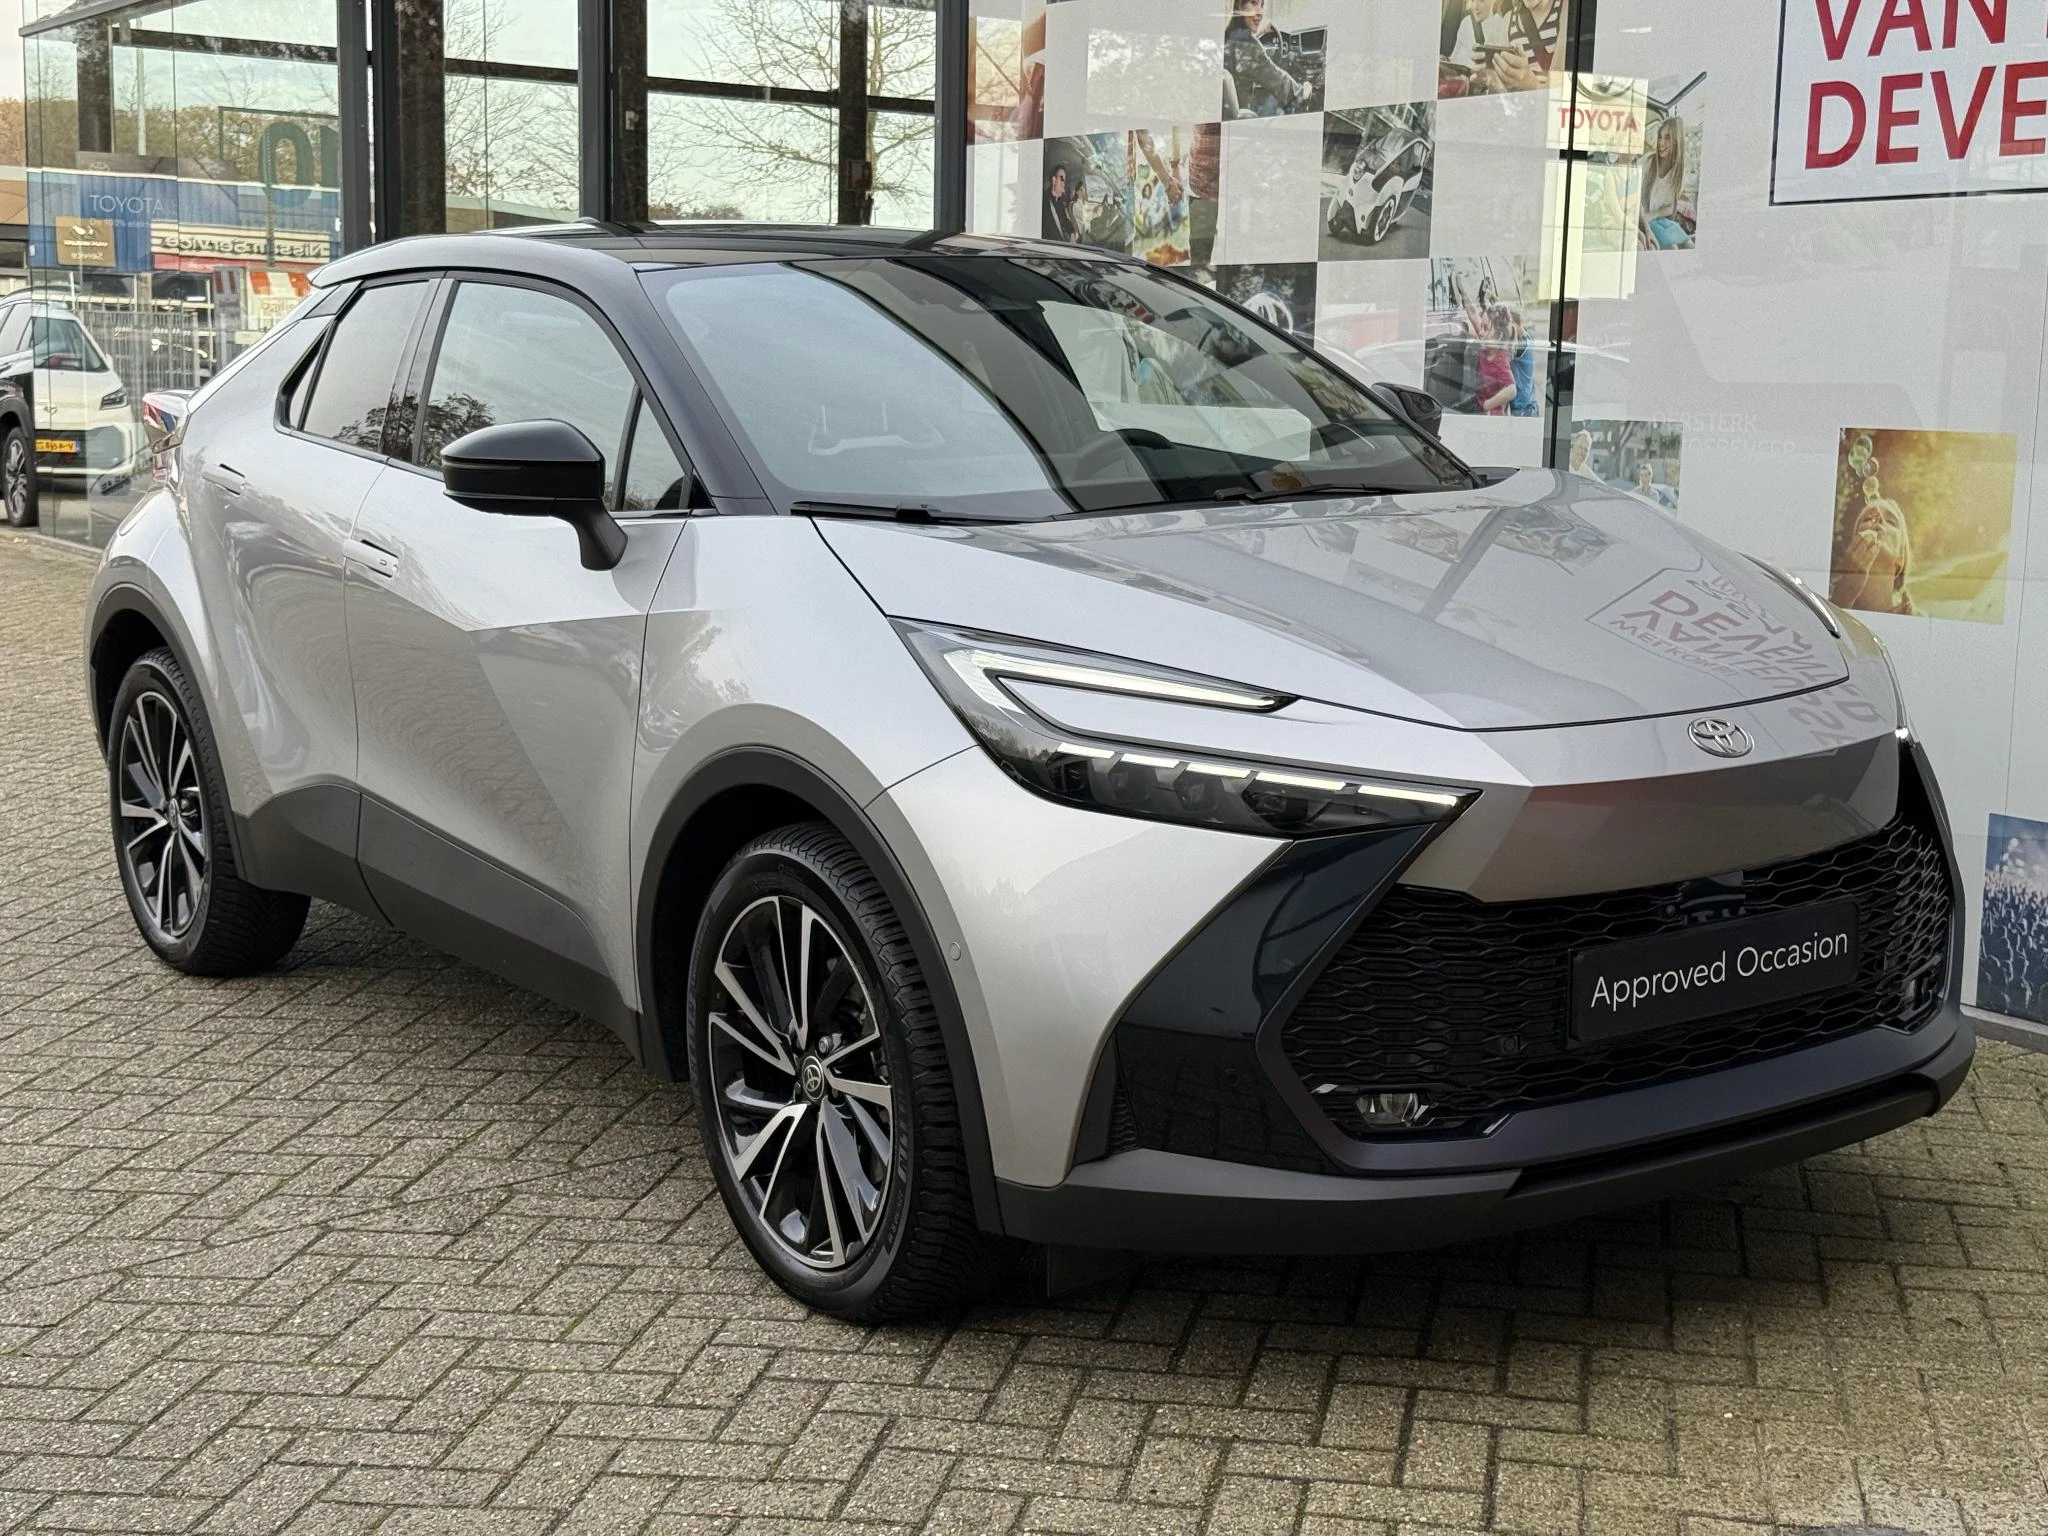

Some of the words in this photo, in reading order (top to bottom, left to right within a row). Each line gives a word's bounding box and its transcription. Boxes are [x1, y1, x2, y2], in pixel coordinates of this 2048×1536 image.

[1815, 0, 2007, 61] VAN
[1557, 108, 1637, 132] TOYOTA
[1805, 61, 2048, 169] DEVE
[89, 194, 165, 214] TOYOTA
[1590, 950, 1727, 1012] Approved
[1736, 931, 1848, 977] Occasion
